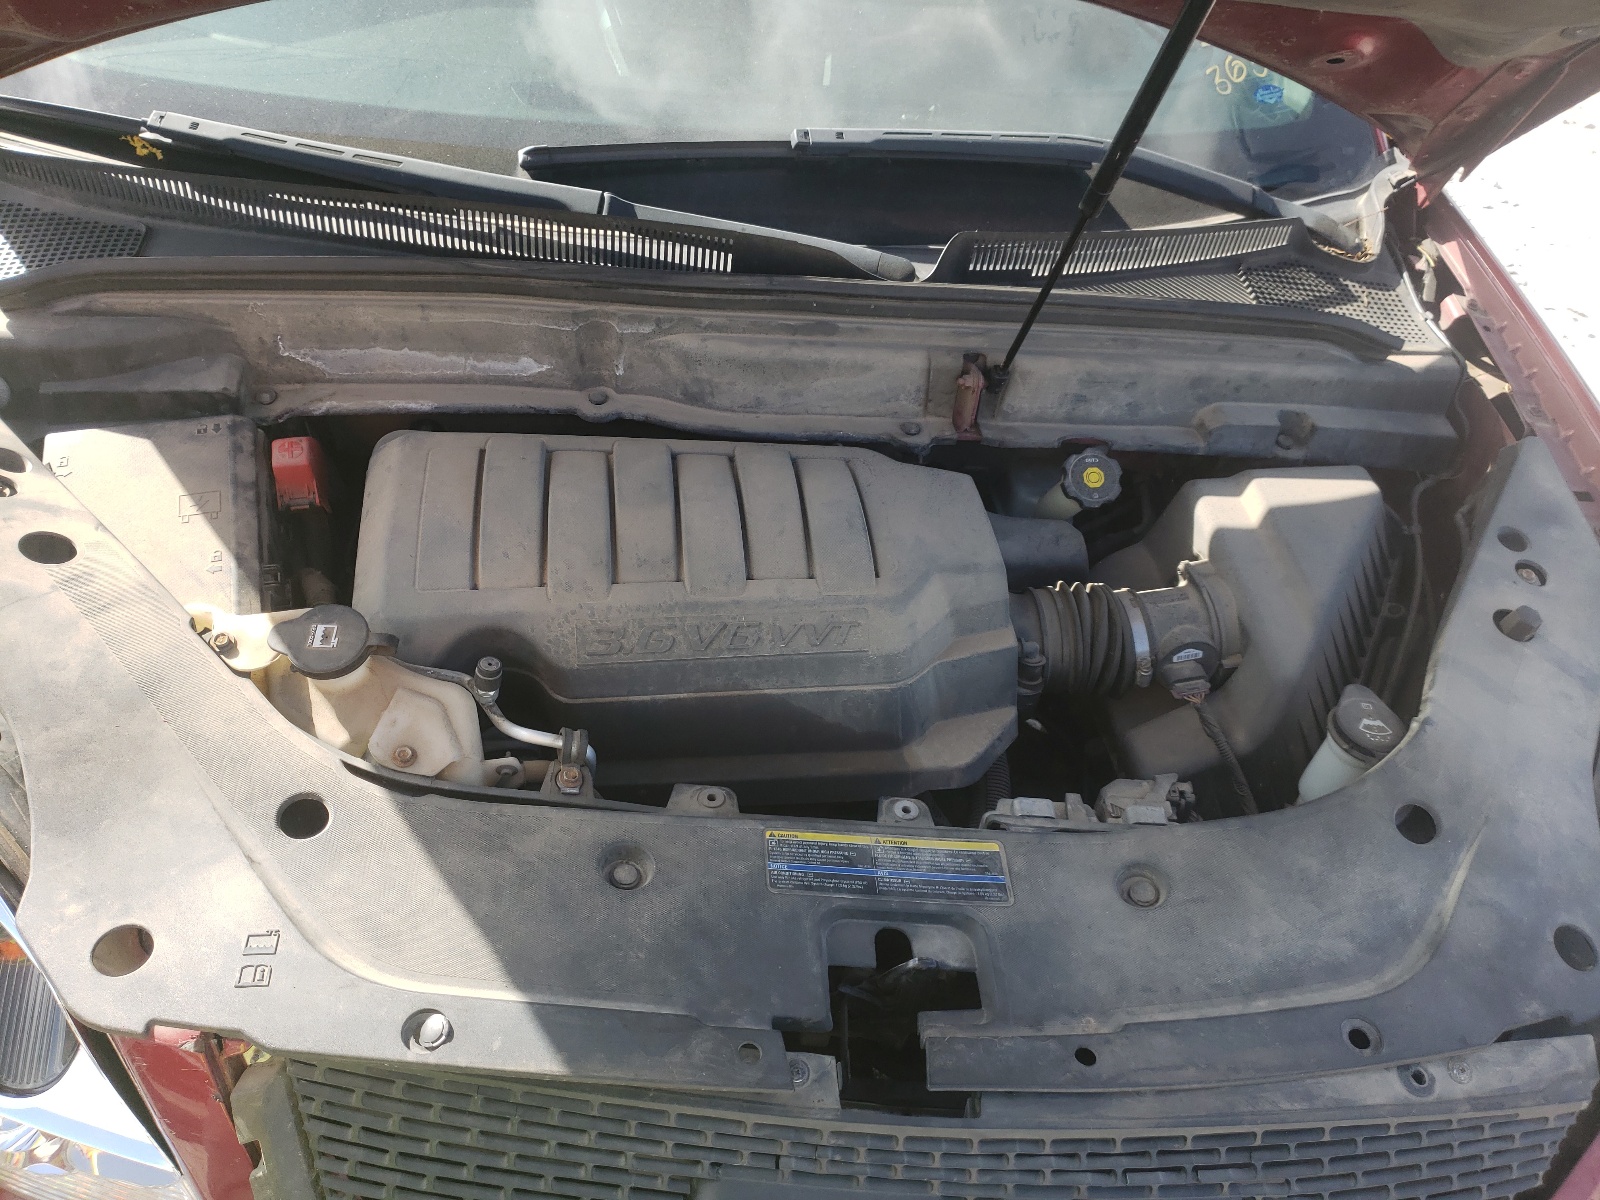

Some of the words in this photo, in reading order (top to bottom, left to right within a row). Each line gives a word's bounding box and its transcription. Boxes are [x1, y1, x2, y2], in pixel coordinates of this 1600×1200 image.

[585, 623, 677, 656] 3.6
[686, 620, 763, 651] V6
[770, 620, 862, 648] VVT
